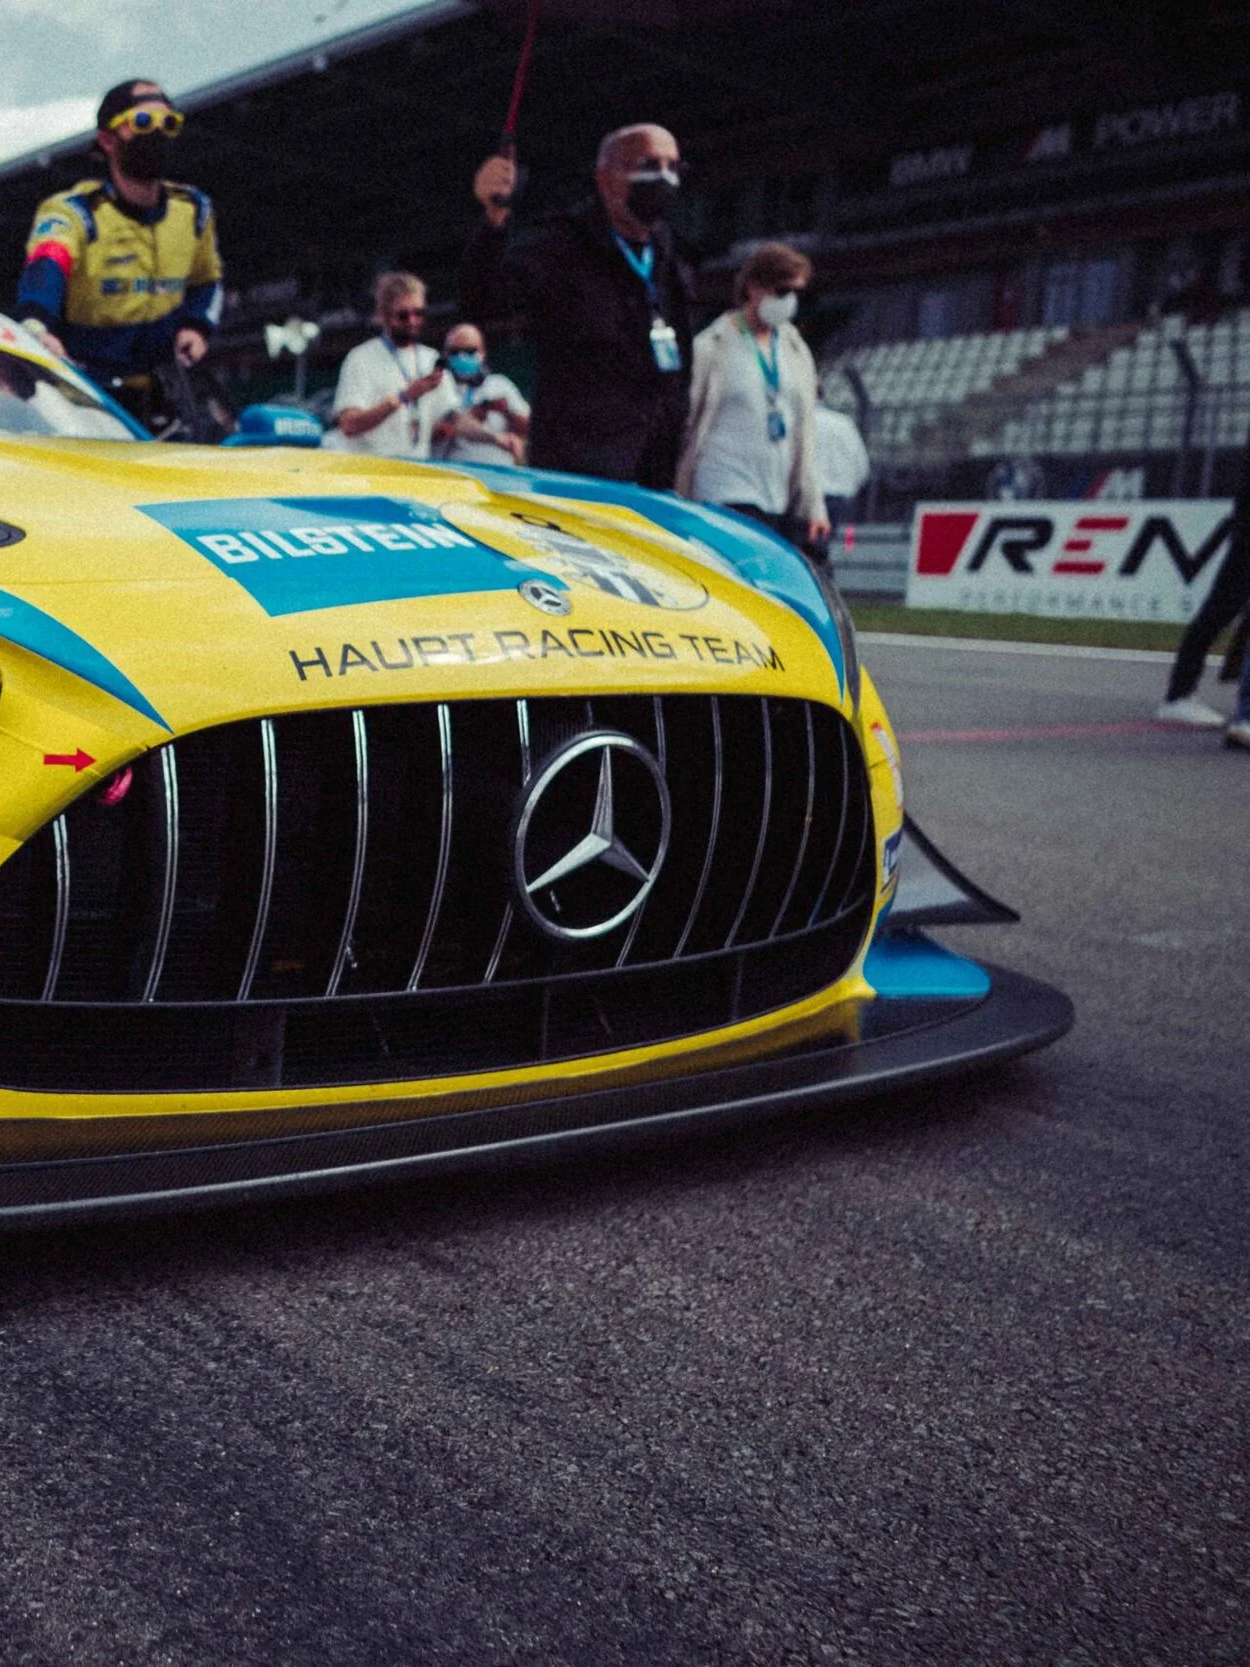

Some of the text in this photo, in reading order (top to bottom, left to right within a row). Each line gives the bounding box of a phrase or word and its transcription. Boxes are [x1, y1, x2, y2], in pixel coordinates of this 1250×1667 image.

[197, 522, 478, 565] BILSTEIN
[289, 629, 786, 681] HAUPT RACING TEAM
